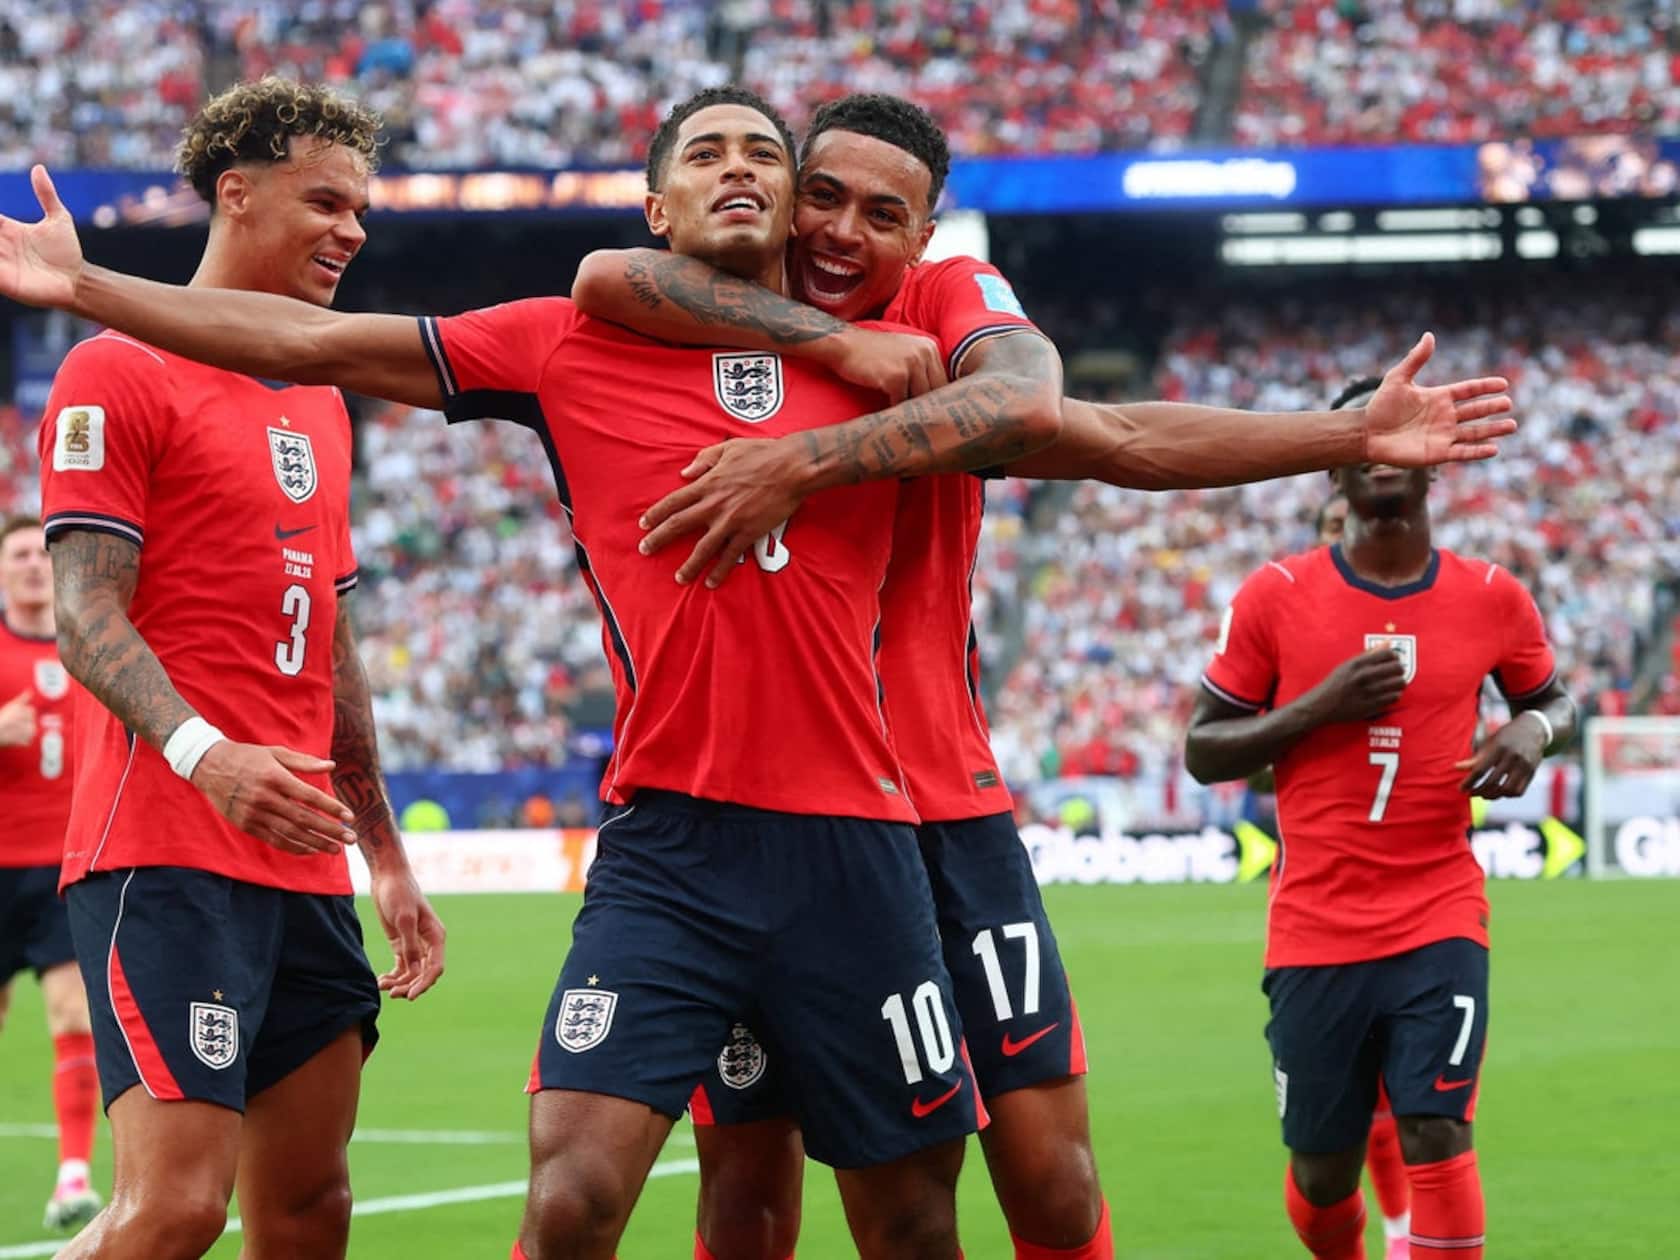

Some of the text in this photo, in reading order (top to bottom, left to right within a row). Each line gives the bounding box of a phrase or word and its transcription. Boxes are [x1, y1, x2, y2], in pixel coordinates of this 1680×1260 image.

[282, 547, 314, 565] PANAMA
[274, 583, 311, 677] 3
[1368, 752, 1400, 822] 7
[971, 922, 1040, 1022] 17
[880, 980, 955, 1085] 10
[1447, 994, 1475, 1066] 7
